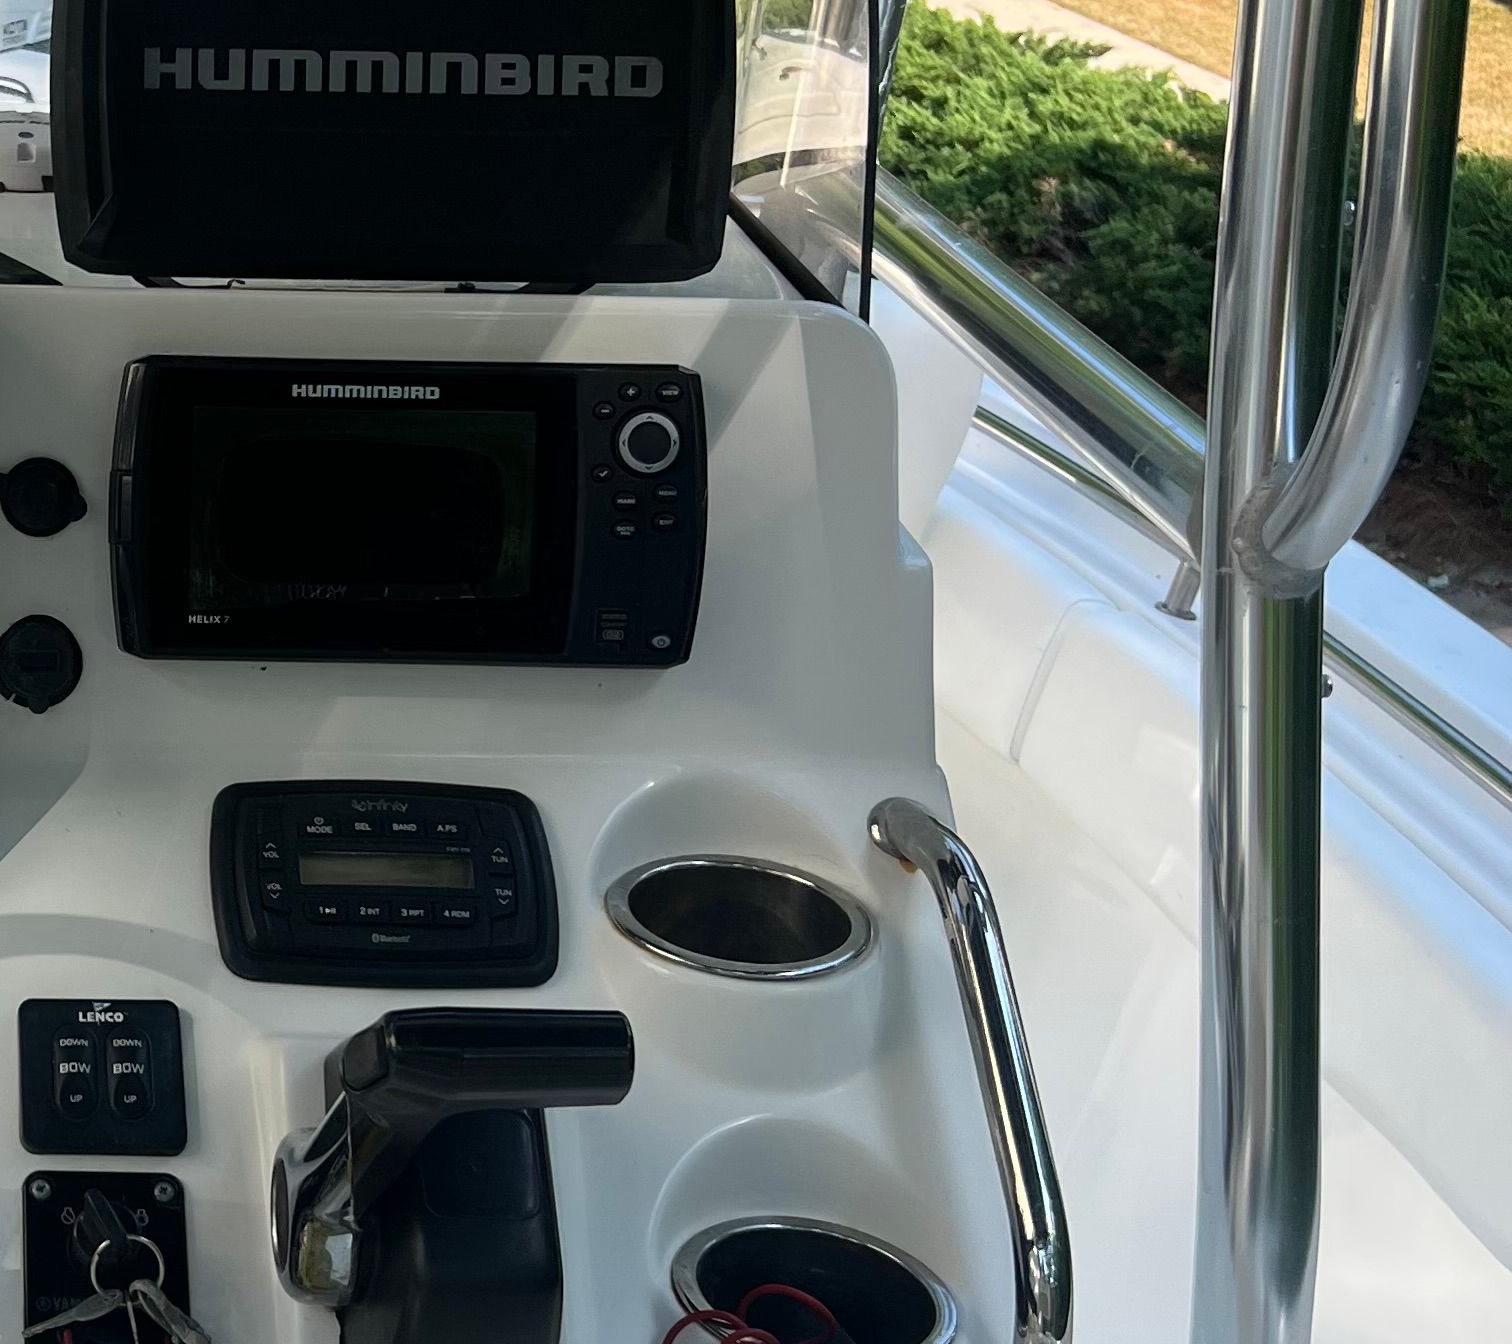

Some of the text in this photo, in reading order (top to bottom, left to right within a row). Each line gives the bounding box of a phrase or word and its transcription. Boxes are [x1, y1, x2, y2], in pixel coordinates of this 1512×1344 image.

[143, 47, 664, 98] HUMMINBIRD
[291, 383, 441, 400] HUMMINBIRD
[188, 614, 221, 625] HELIX
[78, 1011, 124, 1024] LENCO
[59, 1038, 142, 1049] DOWN DOWN
[59, 1062, 145, 1075] BOW BOW
[70, 1094, 137, 1104] UP UP
